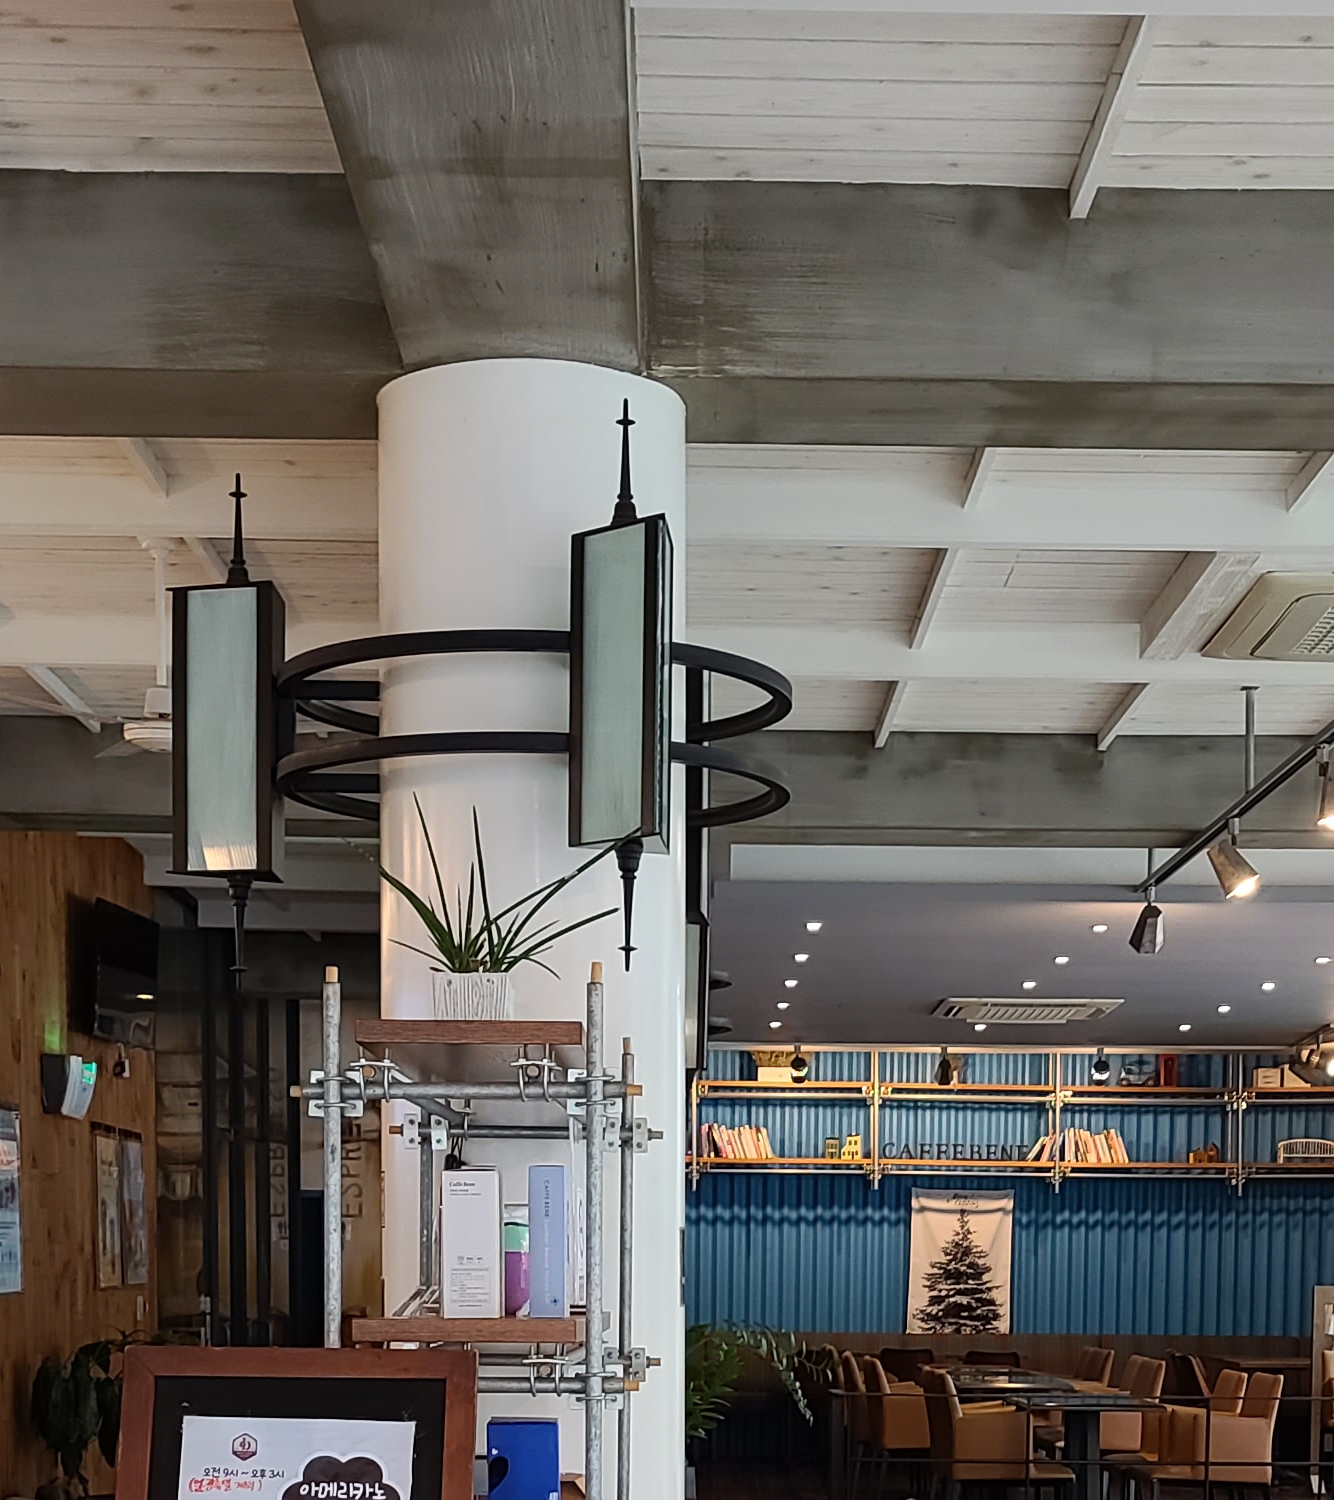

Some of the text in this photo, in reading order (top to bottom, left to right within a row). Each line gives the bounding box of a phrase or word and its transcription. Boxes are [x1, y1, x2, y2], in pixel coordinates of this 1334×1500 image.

[882, 1142, 1030, 1161] CAFFEBENE
[203, 1466, 221, 1478] 오전
[222, 1467, 239, 1478] 9시
[250, 1468, 267, 1480] 오후
[268, 1469, 285, 1479] 3시
[299, 1481, 387, 1500] 아메리카노
